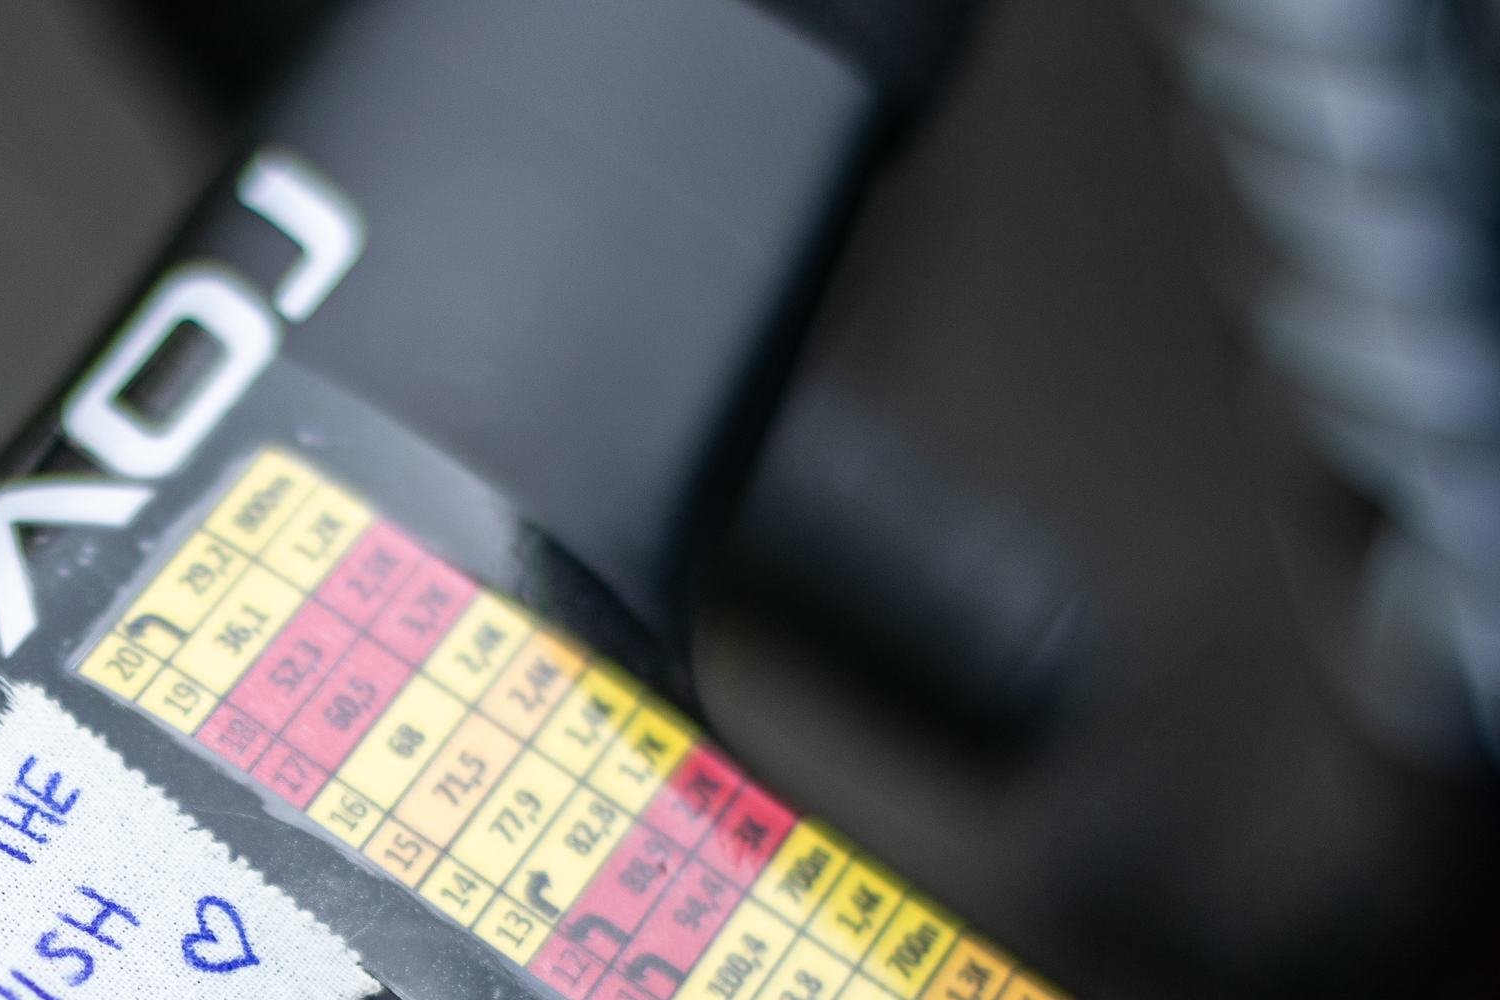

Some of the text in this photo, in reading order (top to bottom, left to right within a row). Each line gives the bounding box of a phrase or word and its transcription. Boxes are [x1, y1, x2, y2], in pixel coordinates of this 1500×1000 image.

[105, 646, 144, 681] 20
[180, 544, 232, 595] 29,2
[163, 682, 199, 716] 19
[215, 605, 267, 654] 36,1
[218, 718, 259, 754] 18
[269, 639, 322, 692] 52,3
[271, 752, 314, 794] 17
[323, 677, 376, 731] 60,5
[329, 796, 367, 831] 16
[388, 724, 424, 758] 68
[384, 833, 422, 871] 15
[433, 751, 486, 805] 71,5
[440, 872, 477, 908] 14
[490, 789, 541, 842] 77,9
[496, 910, 533, 947] 13
[564, 801, 615, 855] 82,8
[673, 876, 725, 931] 94,4
[733, 816, 767, 848] 3K
[780, 846, 829, 900] 700m
[551, 949, 591, 988] 12
[887, 922, 937, 978] 700m
